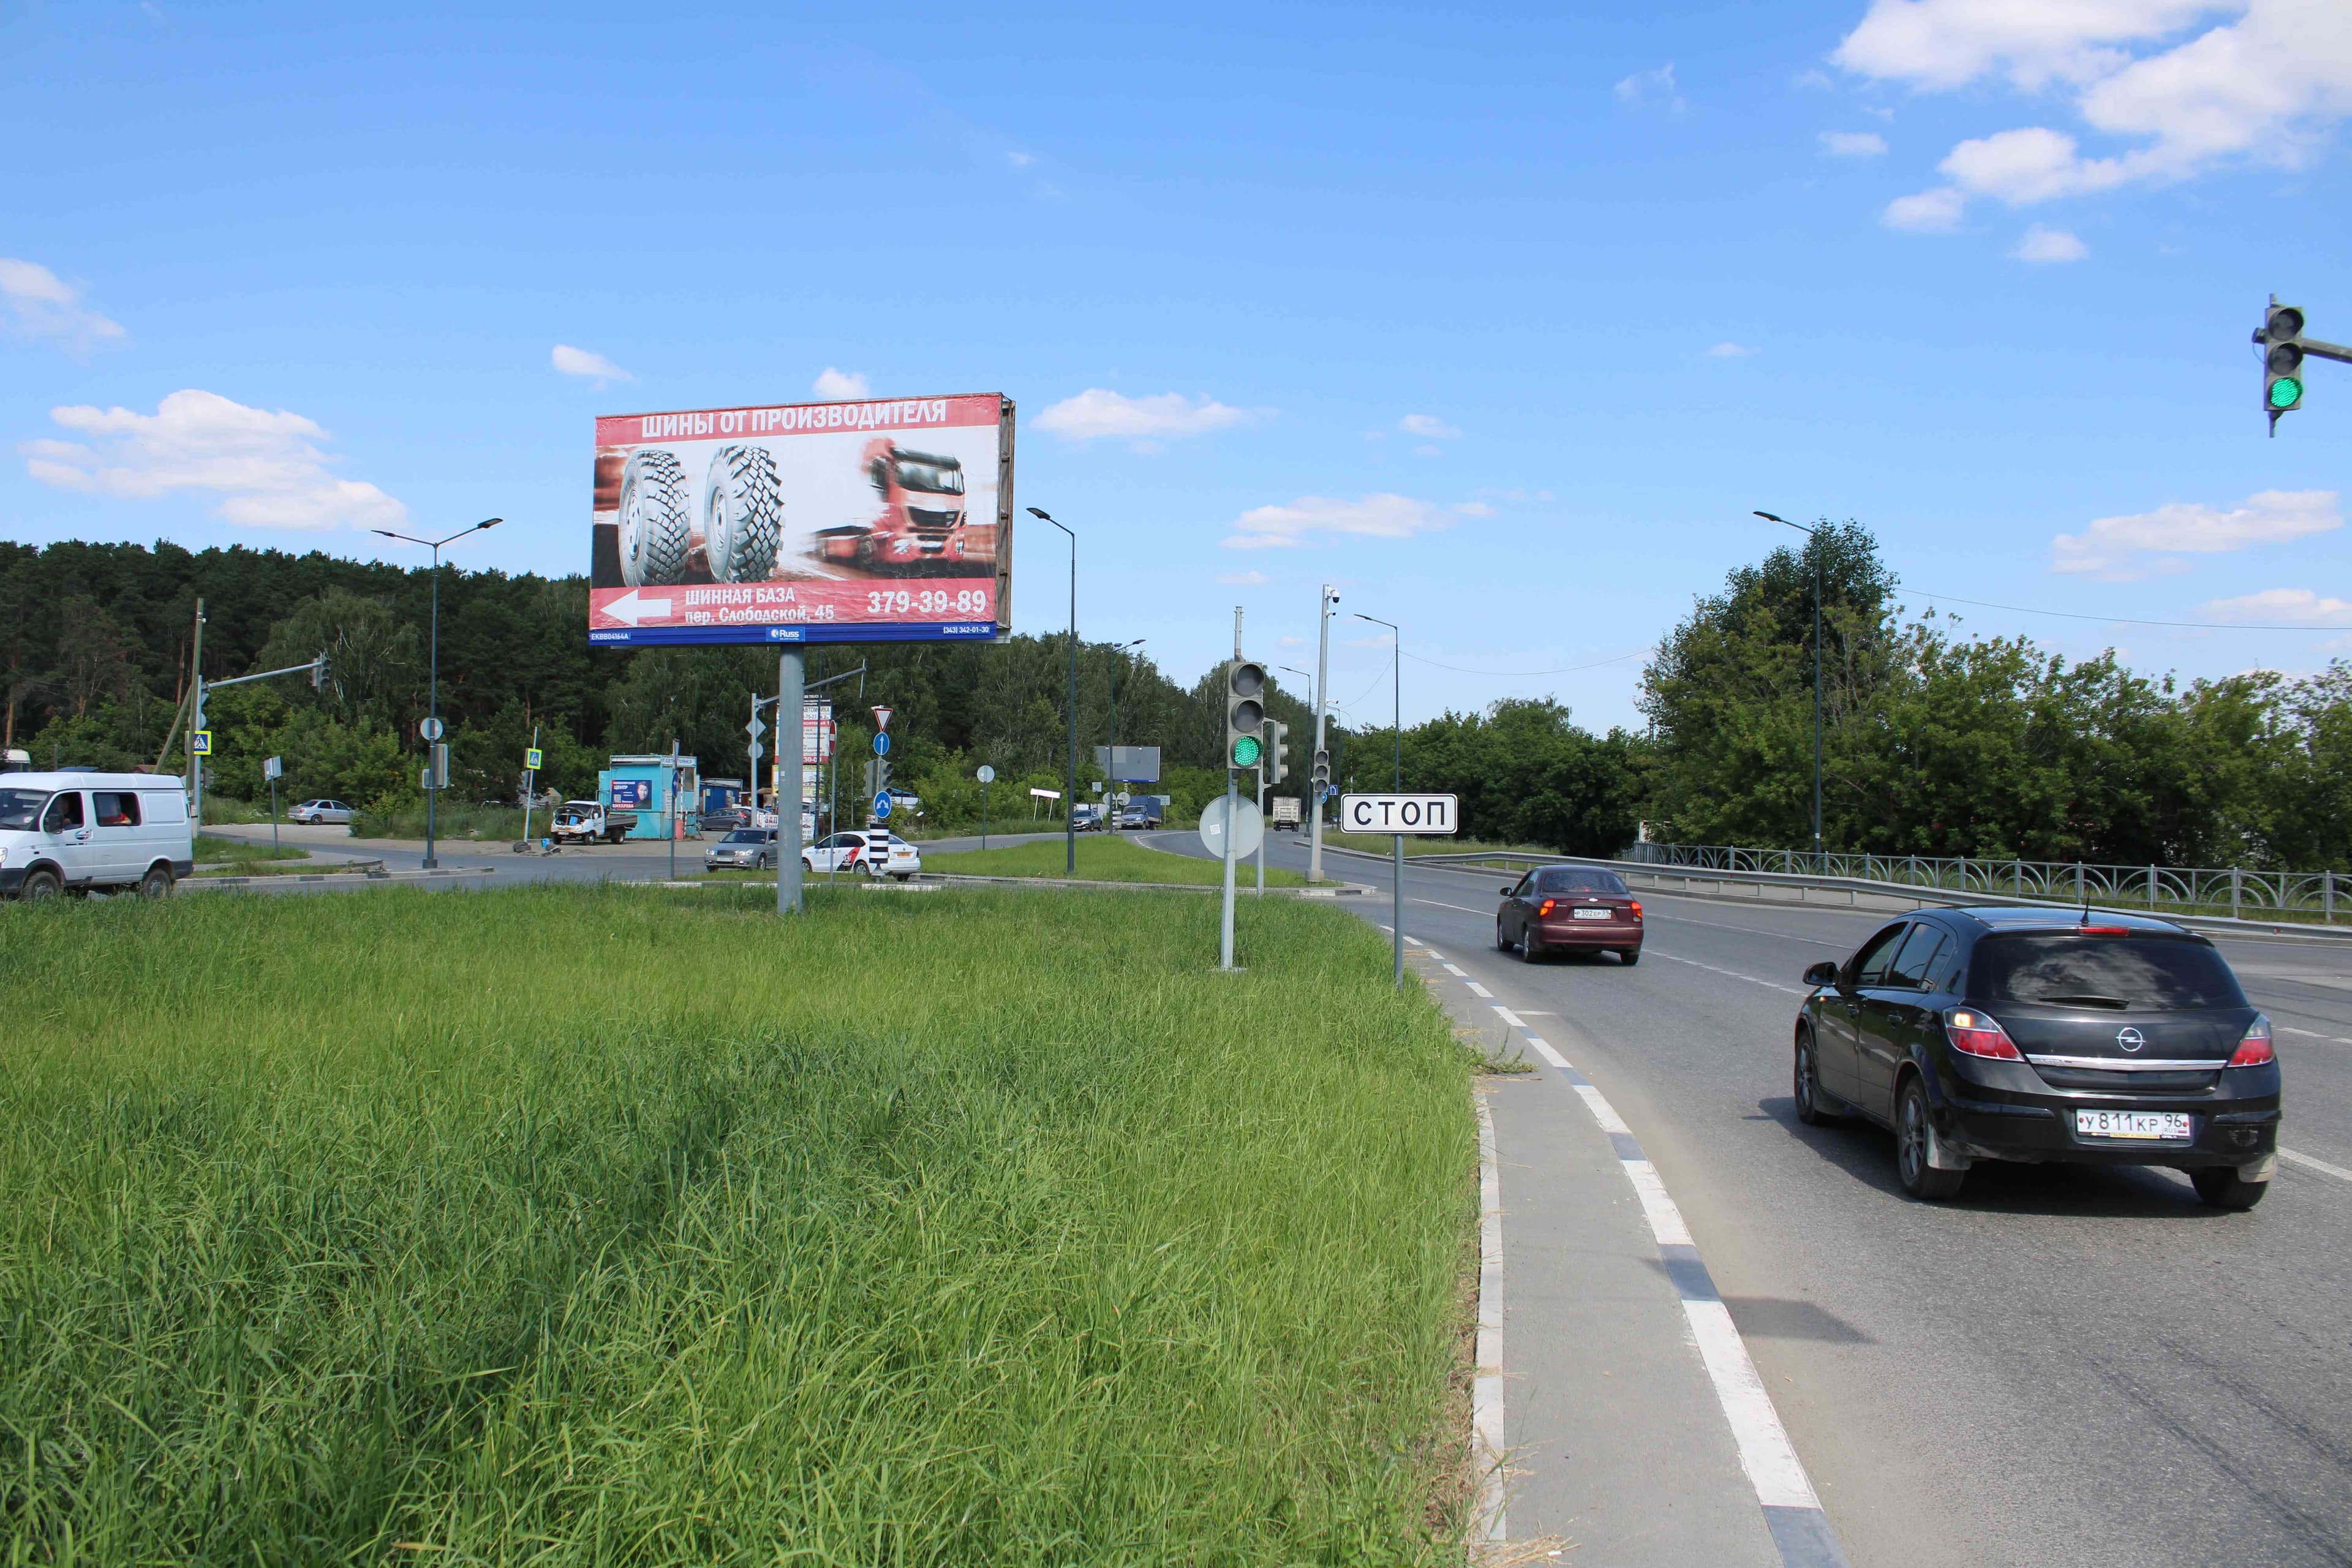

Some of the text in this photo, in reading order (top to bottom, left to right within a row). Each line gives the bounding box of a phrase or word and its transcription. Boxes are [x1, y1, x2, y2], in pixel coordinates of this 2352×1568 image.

[642, 399, 946, 438] ШИНЫ ОТ ПРОИЗВОДИТЕЛЯ
[685, 587, 795, 605] ШИННАЯ БАЗА
[867, 590, 986, 613] 379-39-89
[685, 605, 834, 624] пер. Слободской, 45
[779, 629, 799, 638] Russ
[1354, 801, 1445, 826] СТОП
